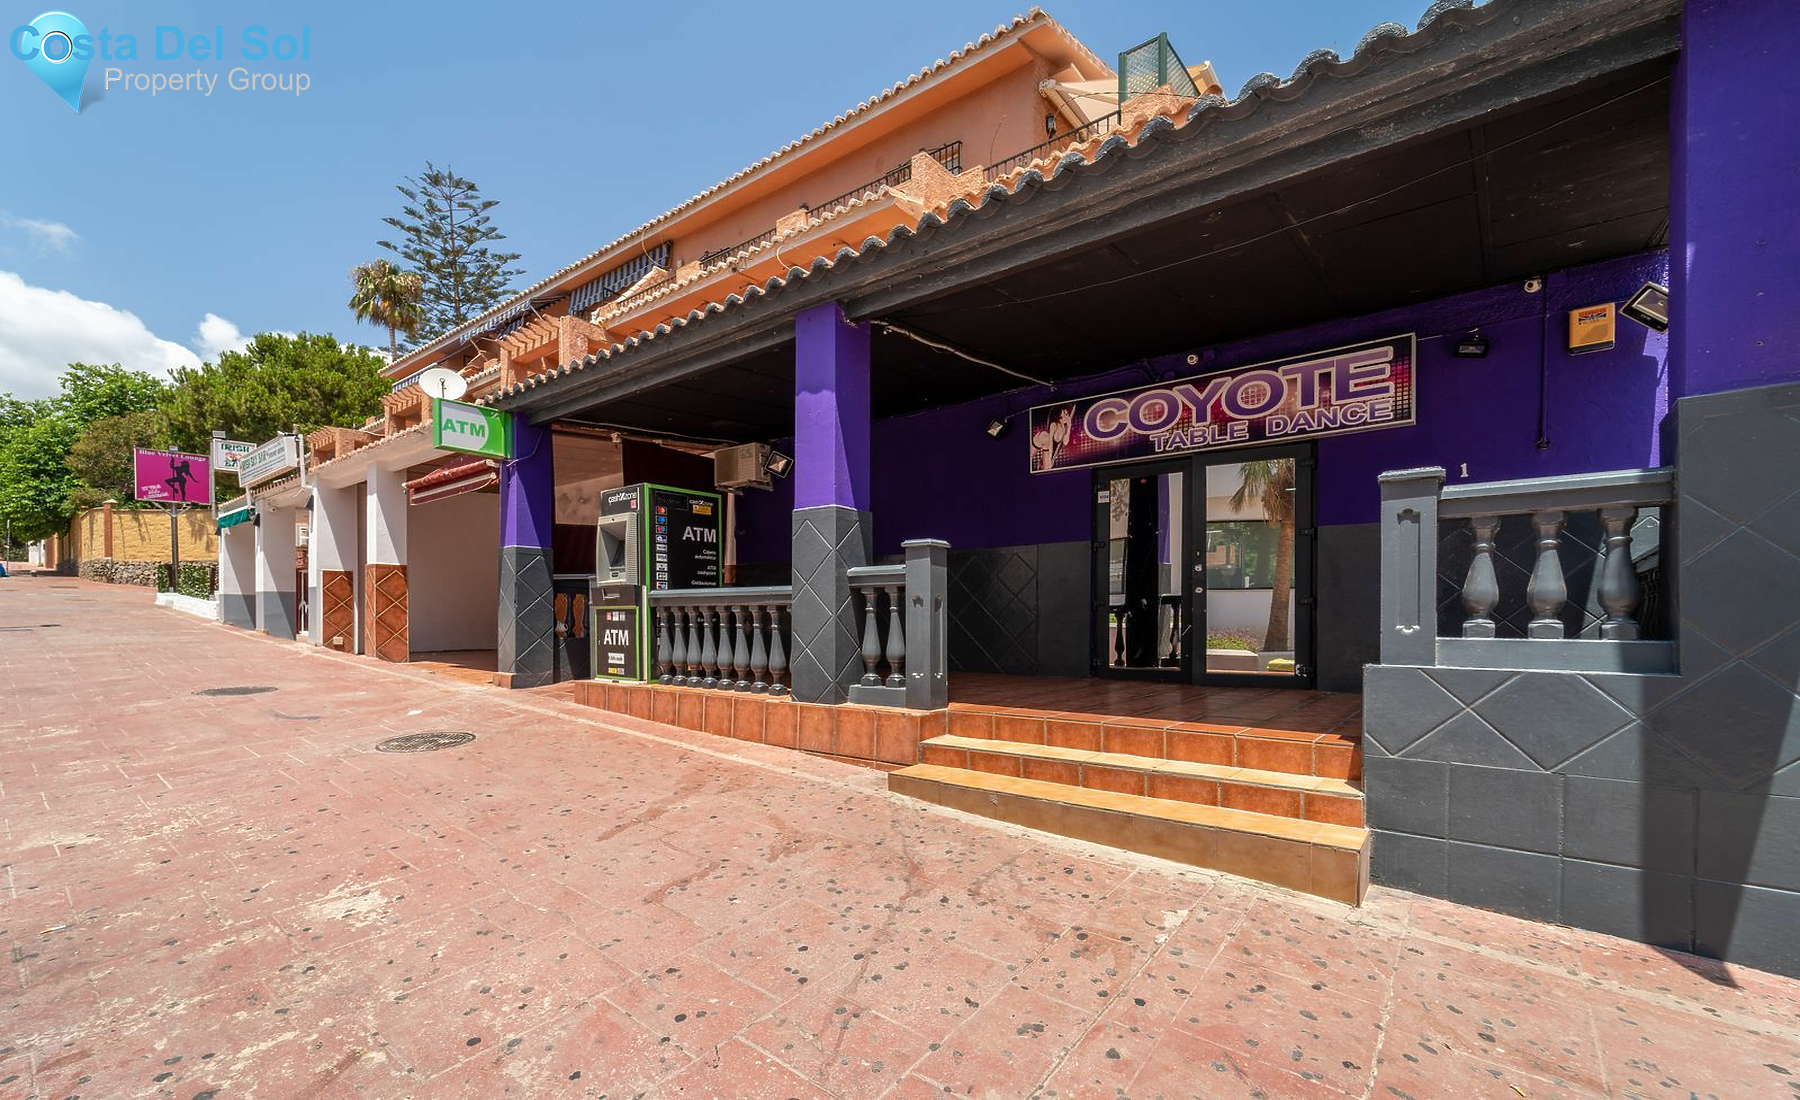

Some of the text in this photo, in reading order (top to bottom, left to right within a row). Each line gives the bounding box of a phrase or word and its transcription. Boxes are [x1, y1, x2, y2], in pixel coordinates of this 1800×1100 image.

[1083, 346, 1395, 442] COYOTE
[442, 418, 486, 438] ATM
[1149, 400, 1395, 453] TABLE DANCE
[158, 451, 179, 459] Velvet
[180, 454, 206, 462] Lounge
[221, 443, 250, 453] IRISH
[1460, 462, 1469, 478] 1
[682, 526, 717, 543] ATM
[603, 629, 629, 646] ATM
